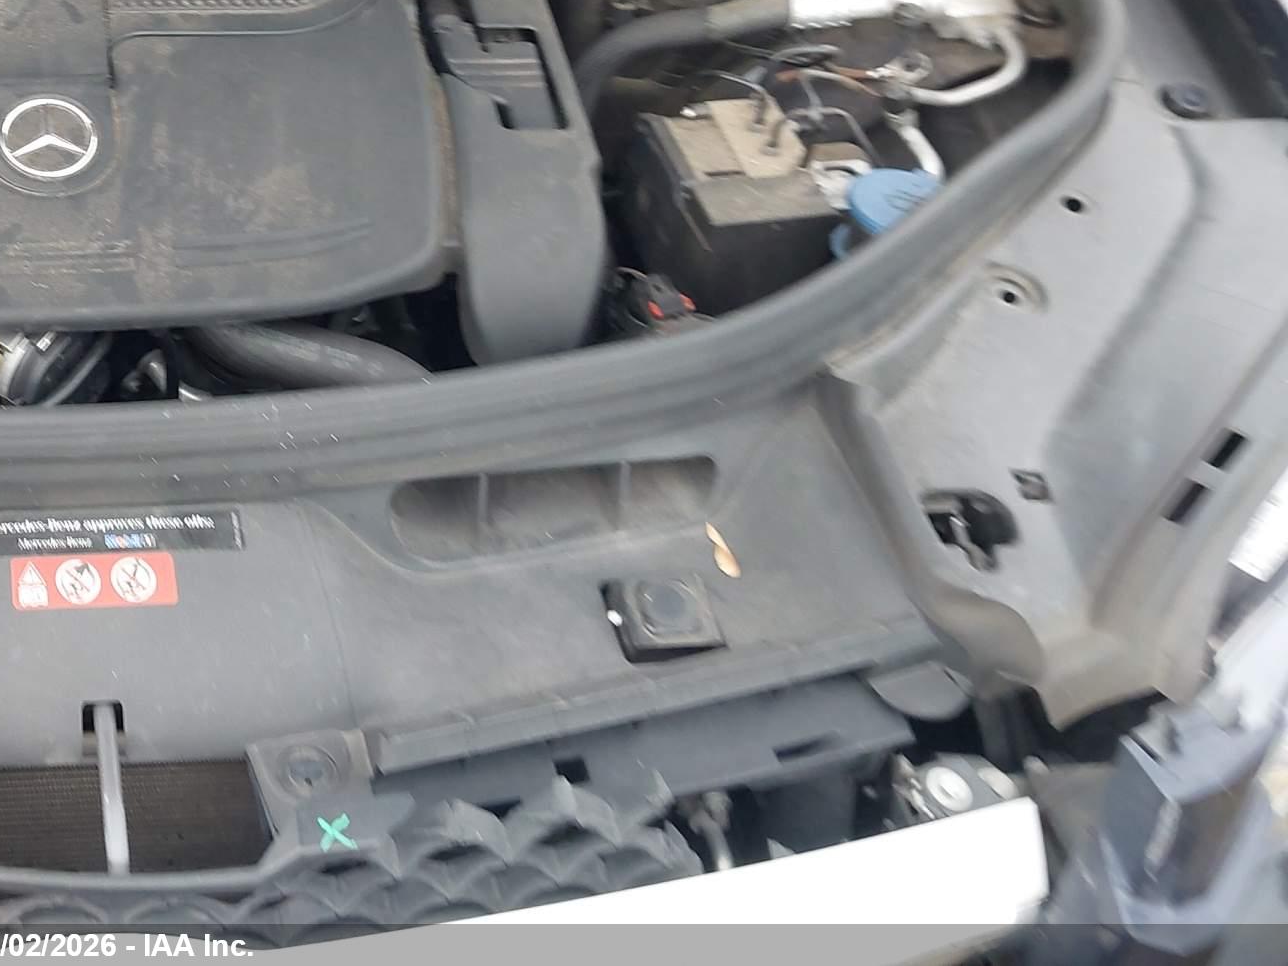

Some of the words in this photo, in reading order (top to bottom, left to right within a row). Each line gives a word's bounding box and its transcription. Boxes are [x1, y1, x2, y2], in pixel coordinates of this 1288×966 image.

[82, 517, 145, 533] approves
[145, 515, 184, 530] these
[16, 535, 93, 551] Mercedes-Benz
